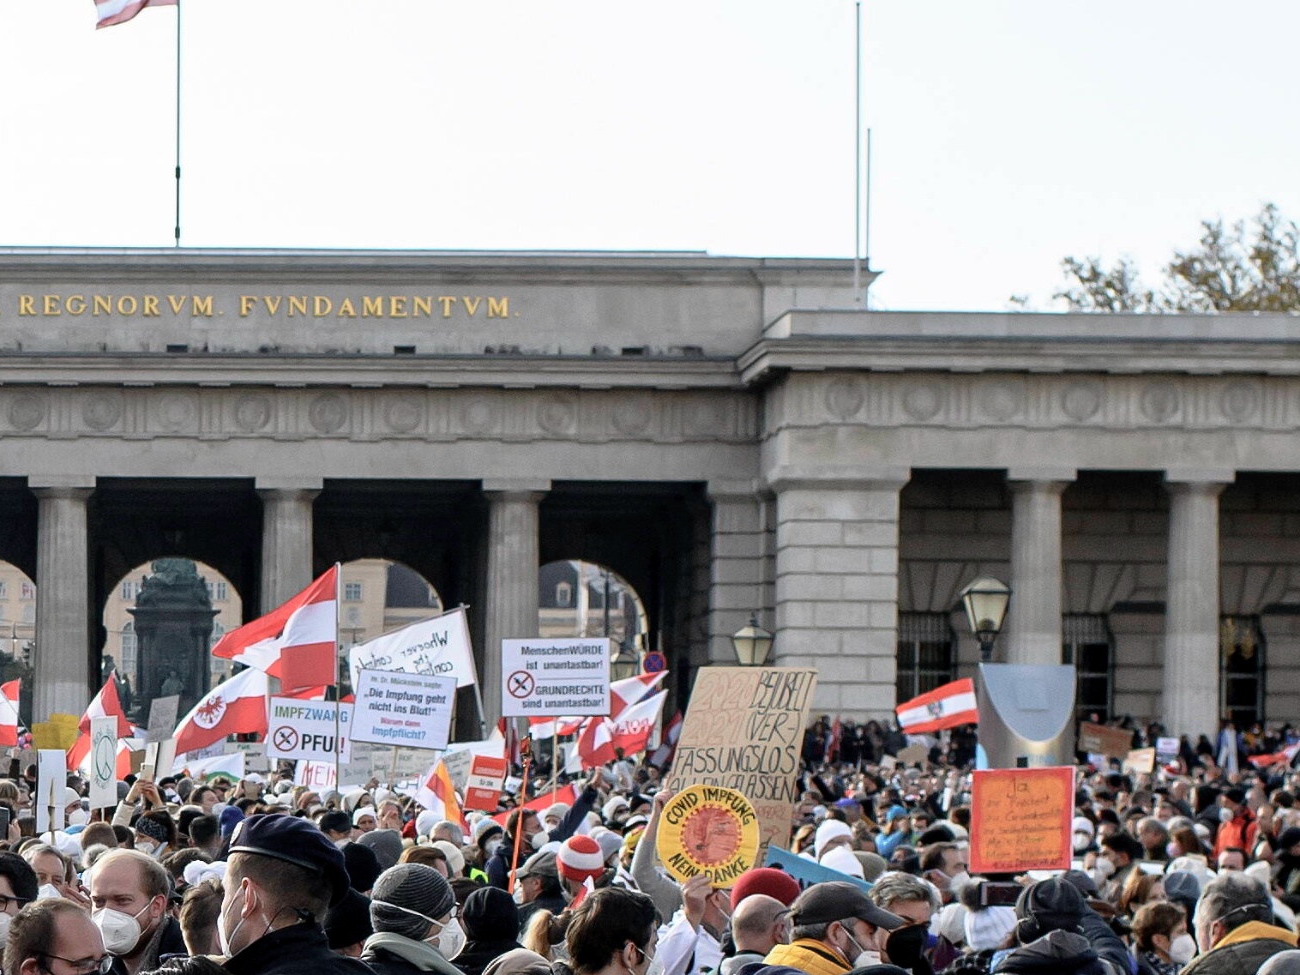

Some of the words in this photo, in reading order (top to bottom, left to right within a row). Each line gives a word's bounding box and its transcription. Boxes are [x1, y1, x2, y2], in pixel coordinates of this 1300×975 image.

[521, 643, 603, 656] MenschenWÜRDE
[526, 660, 538, 670] ist
[543, 660, 604, 670] unantastbar!
[364, 687, 384, 699] „Die
[385, 689, 423, 704] Impfung
[426, 694, 447, 705] geht
[535, 685, 605, 695] GRUNDRECHTE
[368, 700, 392, 712] nicht
[393, 703, 407, 713] ins
[522, 698, 542, 709] sind
[545, 698, 605, 708] unantastbar!
[371, 726, 427, 740] Impfpflicht?
[746, 711, 801, 746] (VER-)
[672, 745, 796, 776] FASSUNGSLOS
[666, 792, 698, 825] COVID
[703, 788, 756, 826] IMPFUNG
[668, 853, 700, 877] NEIN
[704, 856, 750, 883] DANKE
